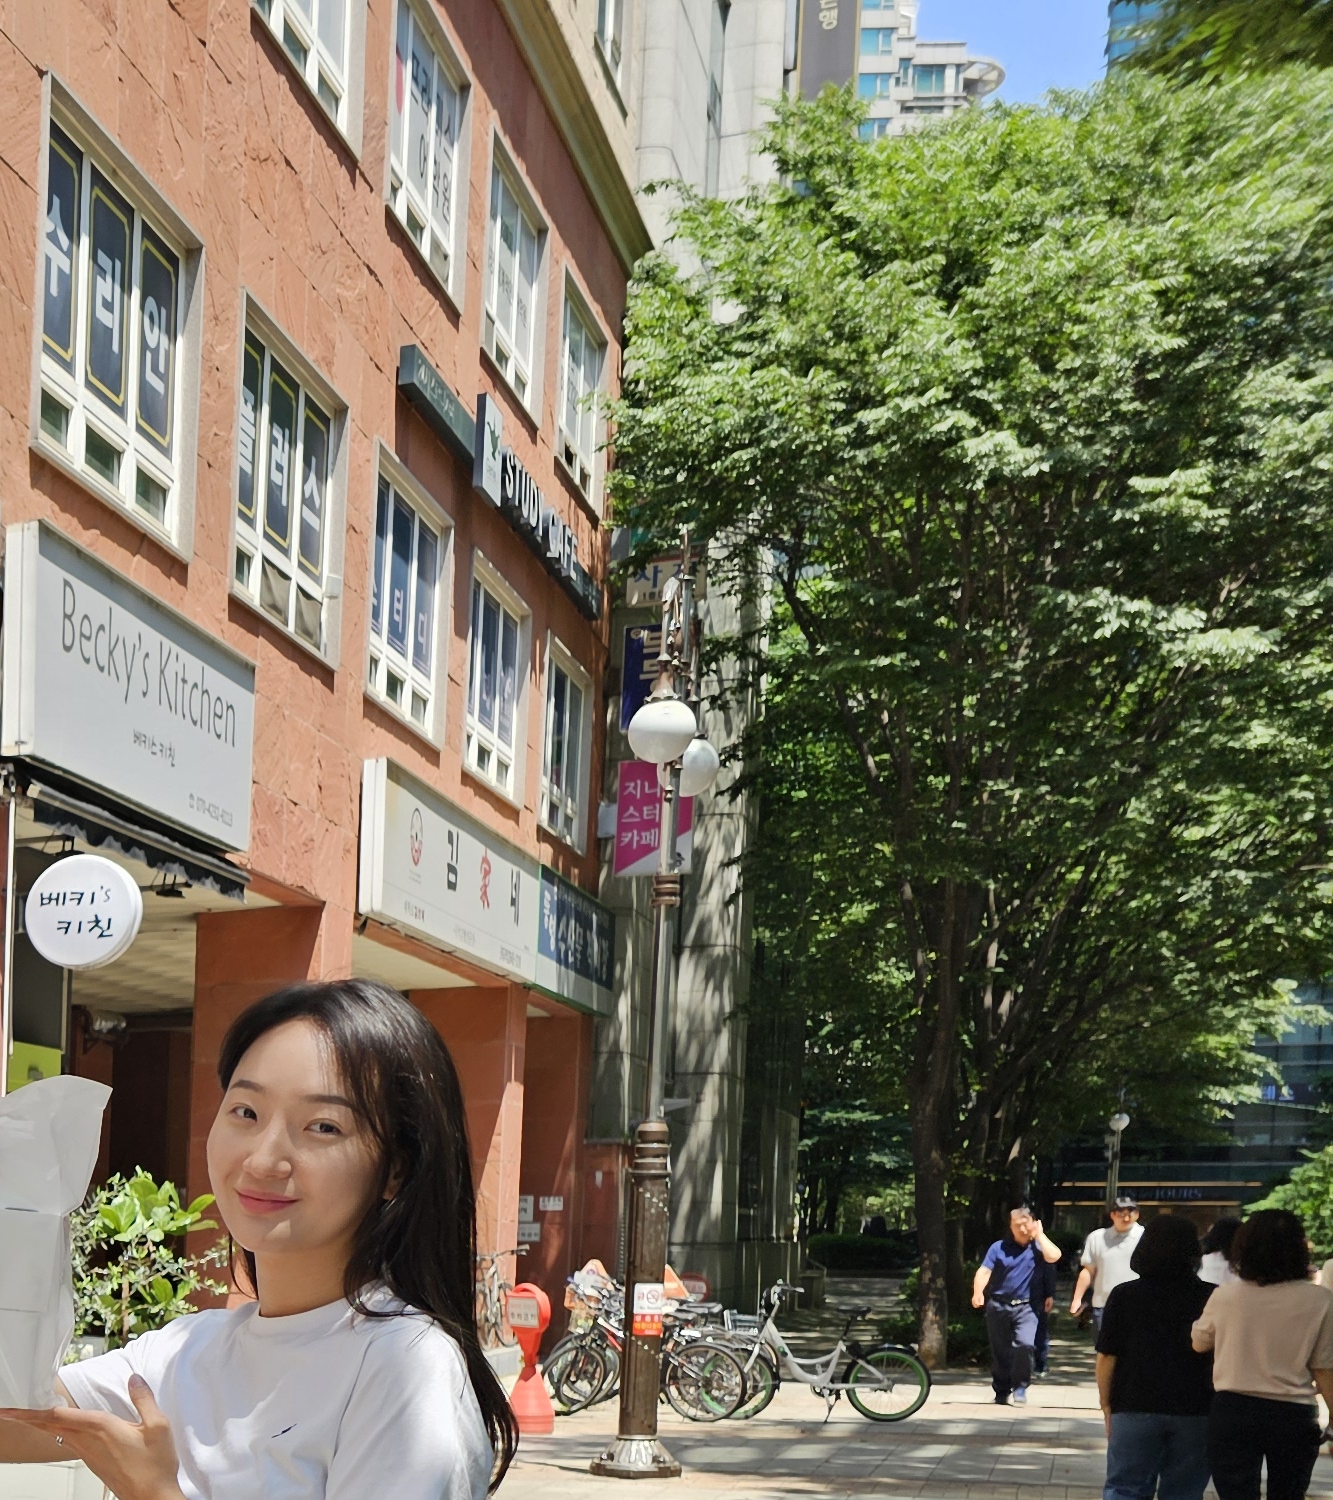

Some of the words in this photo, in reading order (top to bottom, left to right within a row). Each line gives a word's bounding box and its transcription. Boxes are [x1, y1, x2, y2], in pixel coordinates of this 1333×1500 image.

[505, 452, 544, 537] STUDY
[546, 512, 578, 581] CAFE
[62, 578, 150, 704] Becky's
[157, 645, 237, 748] Kitchen
[621, 804, 660, 822] 스터
[620, 828, 659, 849] 카페
[40, 885, 112, 908] 베키's
[56, 914, 114, 939] 키친
